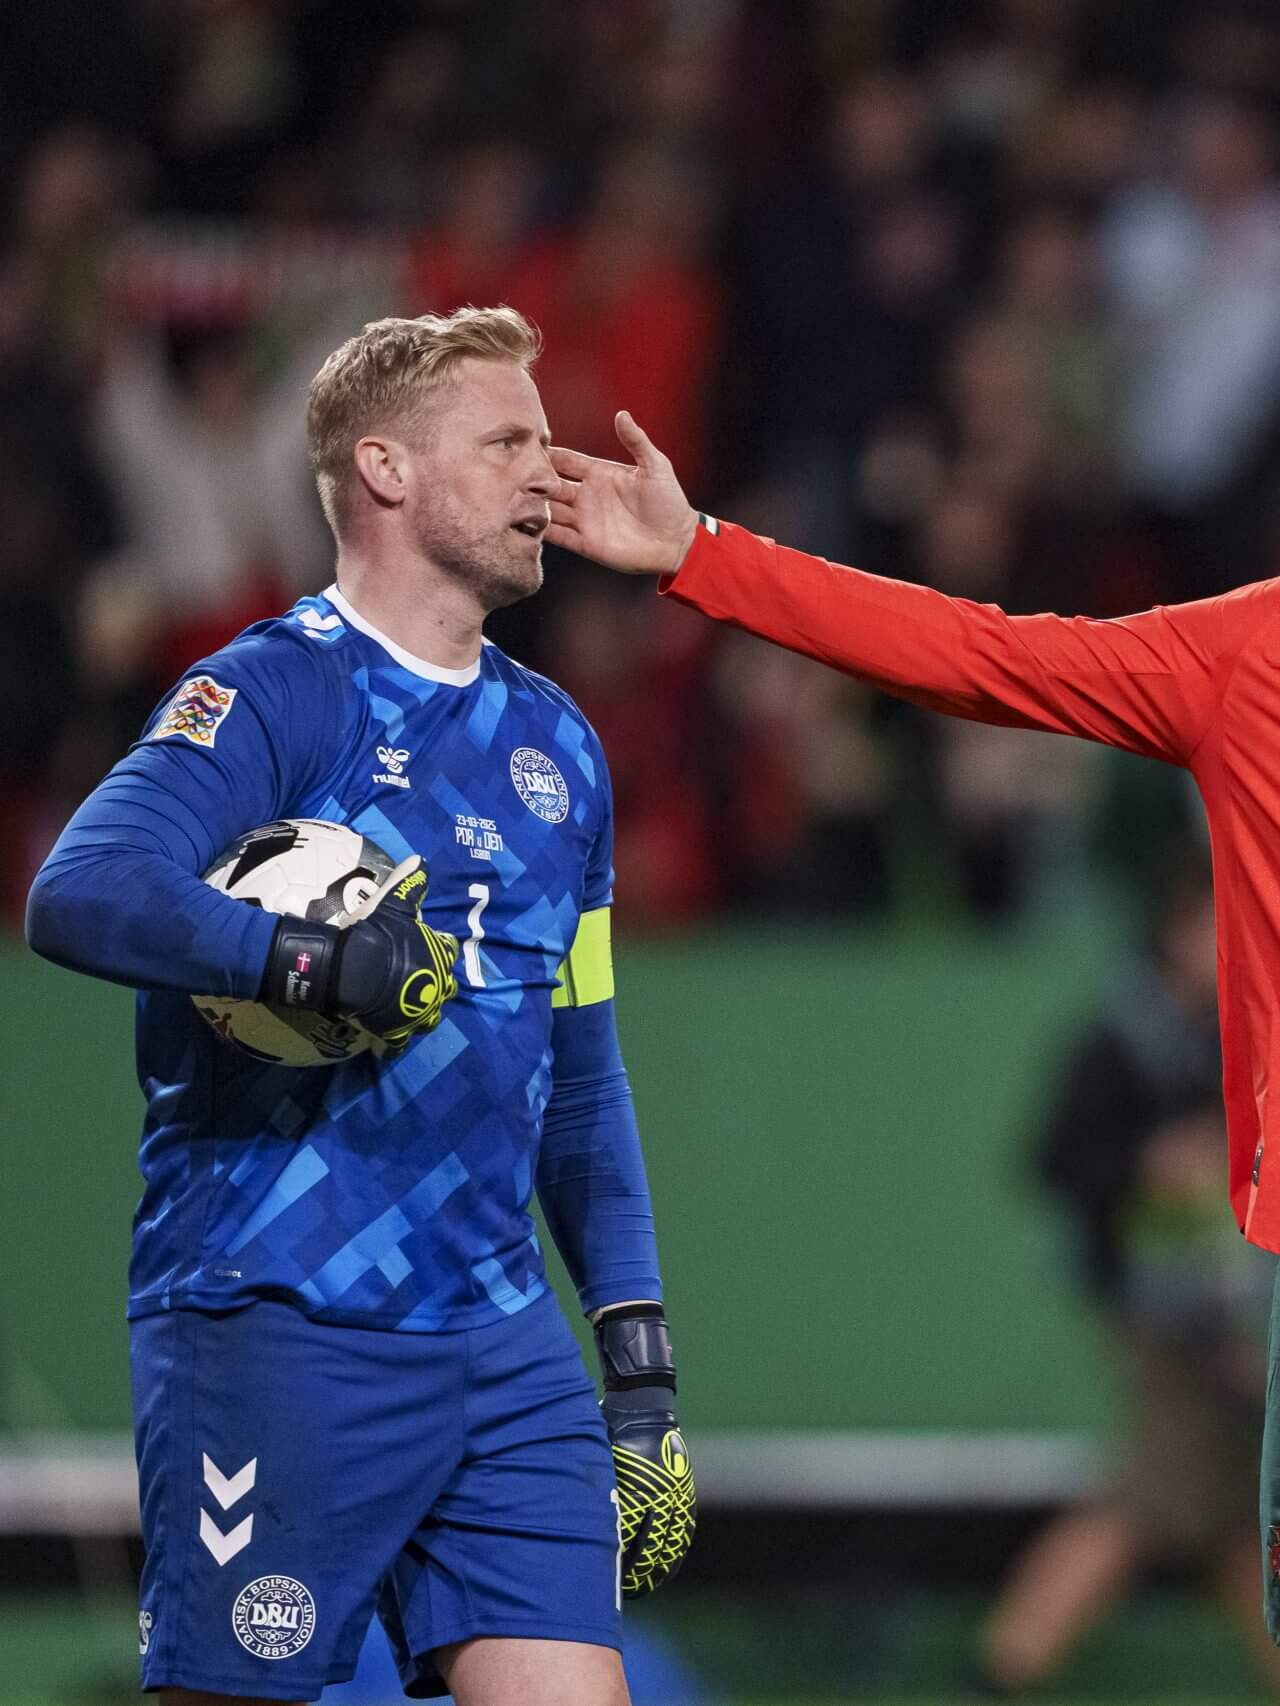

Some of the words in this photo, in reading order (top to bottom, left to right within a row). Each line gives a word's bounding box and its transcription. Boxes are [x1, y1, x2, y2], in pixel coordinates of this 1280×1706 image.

[523, 771, 559, 795] DBU
[455, 826, 475, 847] POR
[483, 831, 504, 852] DEN
[235, 1595, 254, 1645] DANSK
[250, 1602, 300, 1629] DBU
[291, 1604, 313, 1648] UNION
[255, 1644, 289, 1657] 1889
